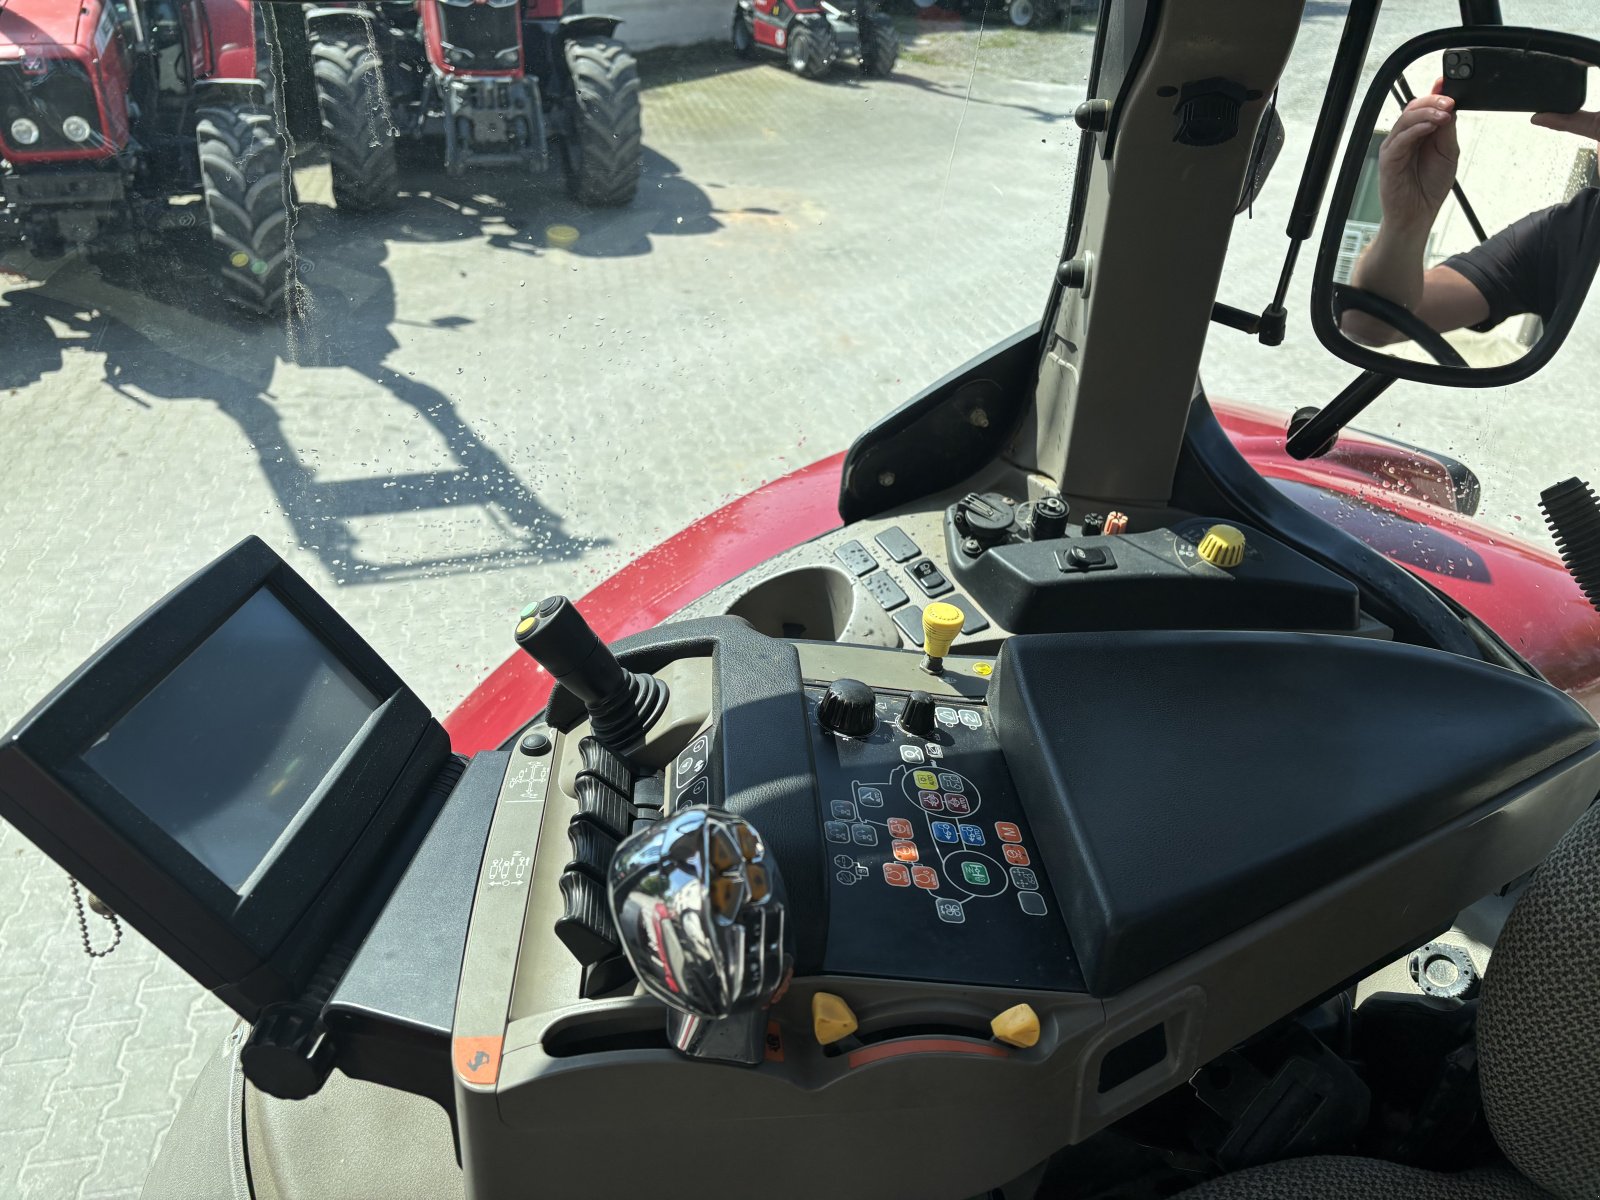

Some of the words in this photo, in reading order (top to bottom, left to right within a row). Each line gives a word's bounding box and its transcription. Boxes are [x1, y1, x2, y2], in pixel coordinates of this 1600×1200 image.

[959, 797, 968, 810] AUTO
[974, 828, 983, 842] AUTO
[1001, 826, 1017, 837] M
